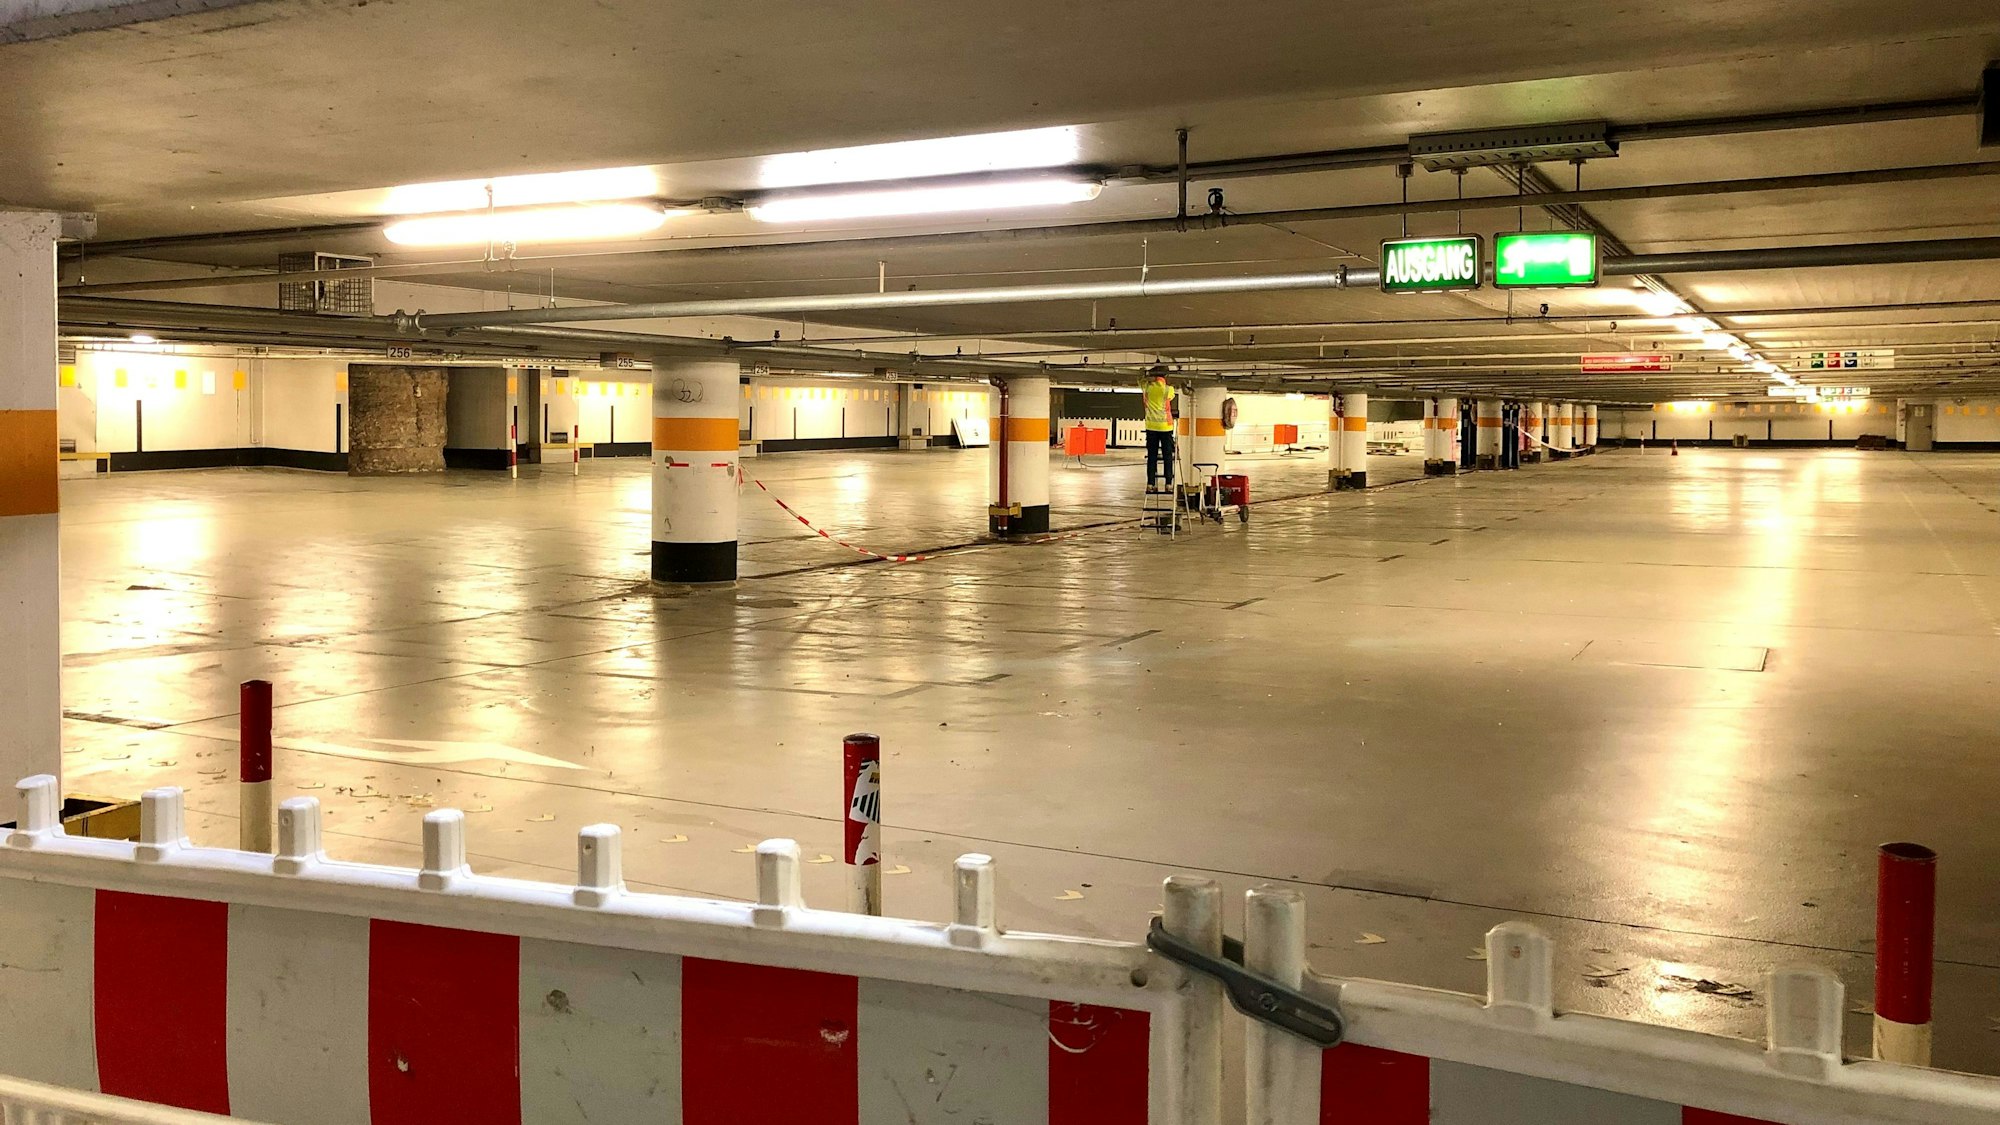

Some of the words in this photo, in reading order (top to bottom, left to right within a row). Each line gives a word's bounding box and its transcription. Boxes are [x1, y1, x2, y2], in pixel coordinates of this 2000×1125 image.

[1386, 244, 1474, 284] AUSGANG
[390, 347, 410, 358] 256
[618, 357, 633, 368] 255
